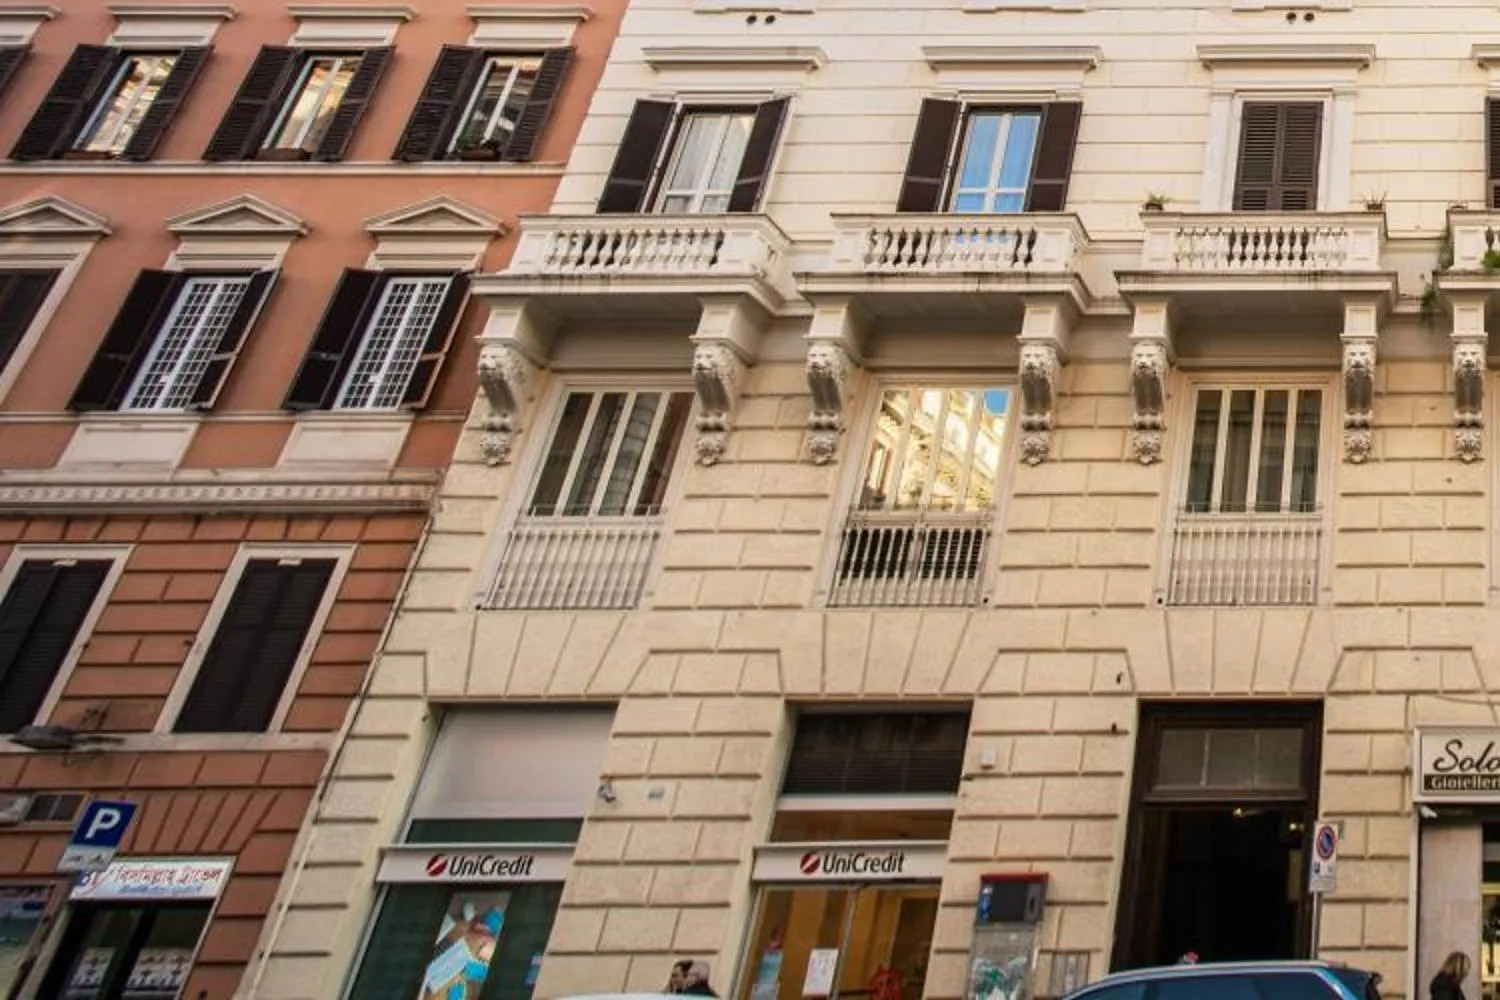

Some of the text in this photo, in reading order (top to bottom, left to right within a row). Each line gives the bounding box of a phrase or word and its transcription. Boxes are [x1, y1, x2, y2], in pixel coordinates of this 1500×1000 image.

[85, 808, 121, 840] P
[450, 855, 535, 877] UniCredit
[824, 852, 906, 874] UniCredit
